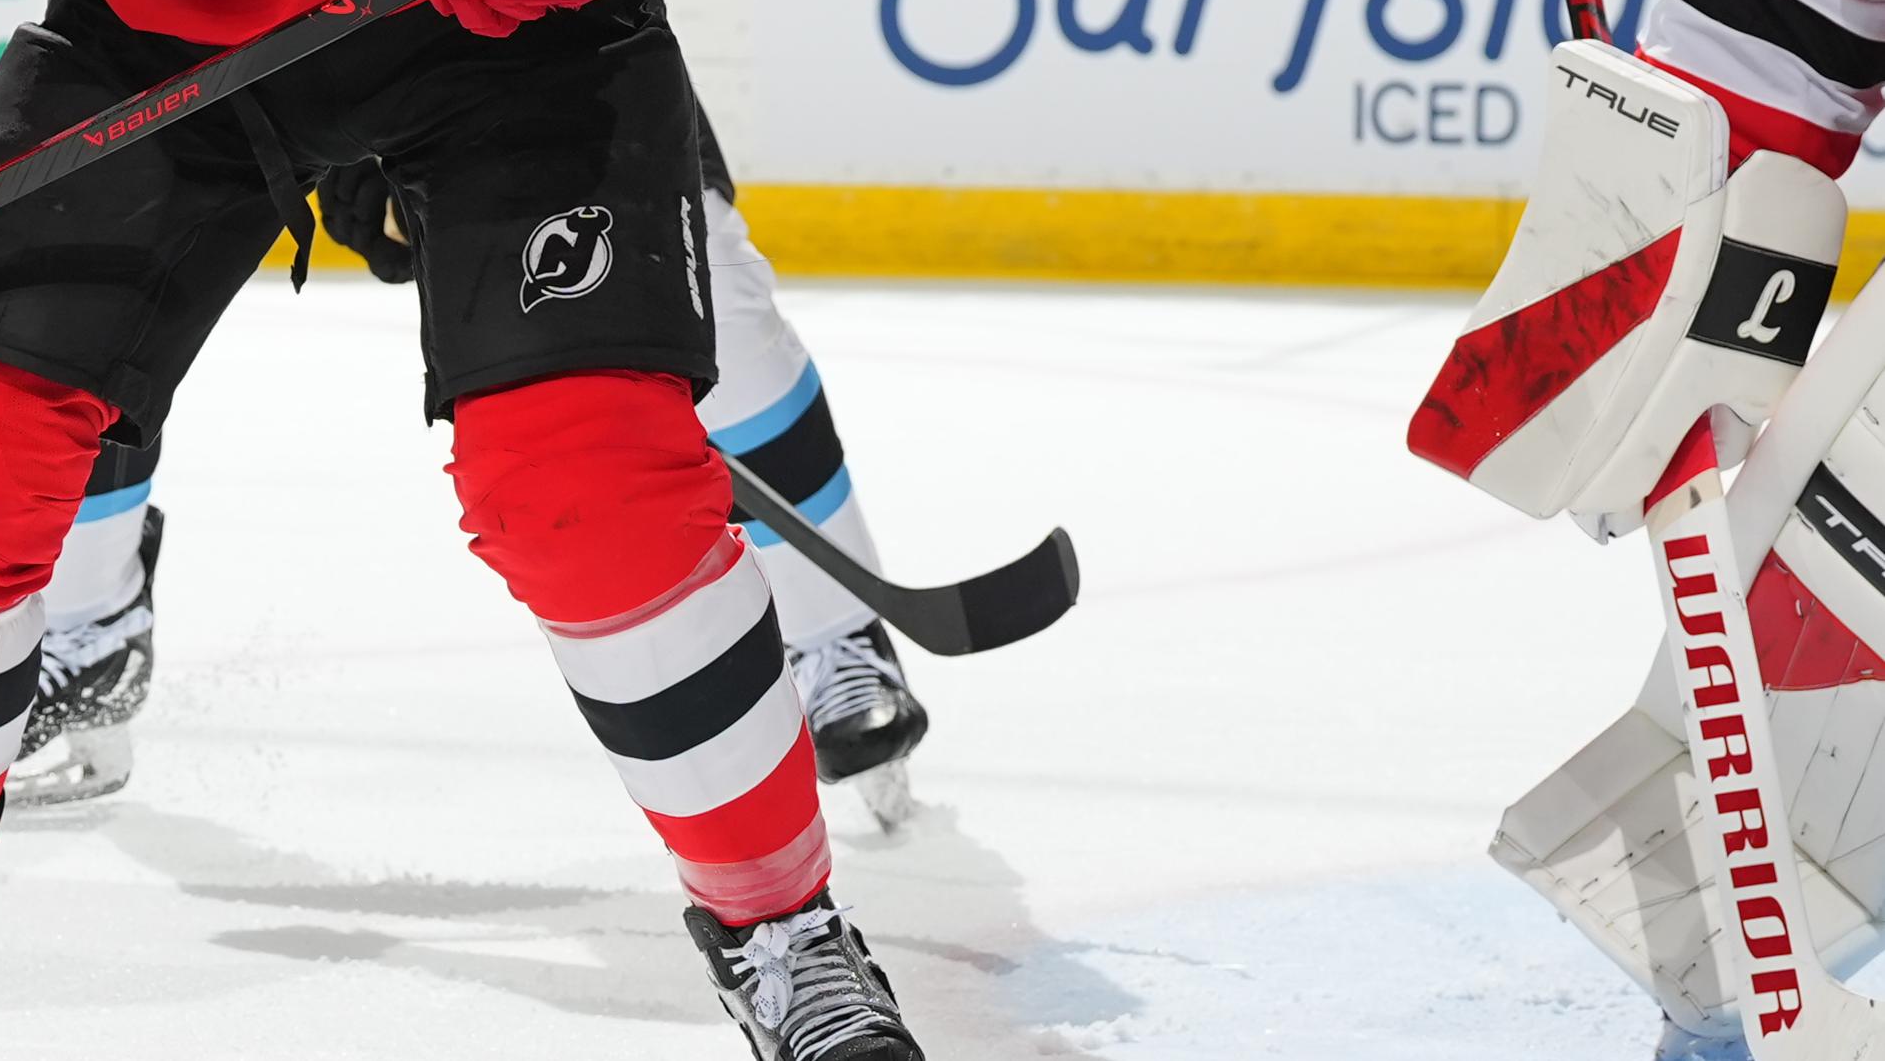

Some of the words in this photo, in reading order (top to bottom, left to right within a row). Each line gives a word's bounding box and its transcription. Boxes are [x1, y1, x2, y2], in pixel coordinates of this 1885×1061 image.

[108, 83, 202, 143] BAUER
[1353, 82, 1519, 146] ICED
[1556, 65, 1680, 139] TRUE
[1663, 534, 1803, 1038] WARRIOR
